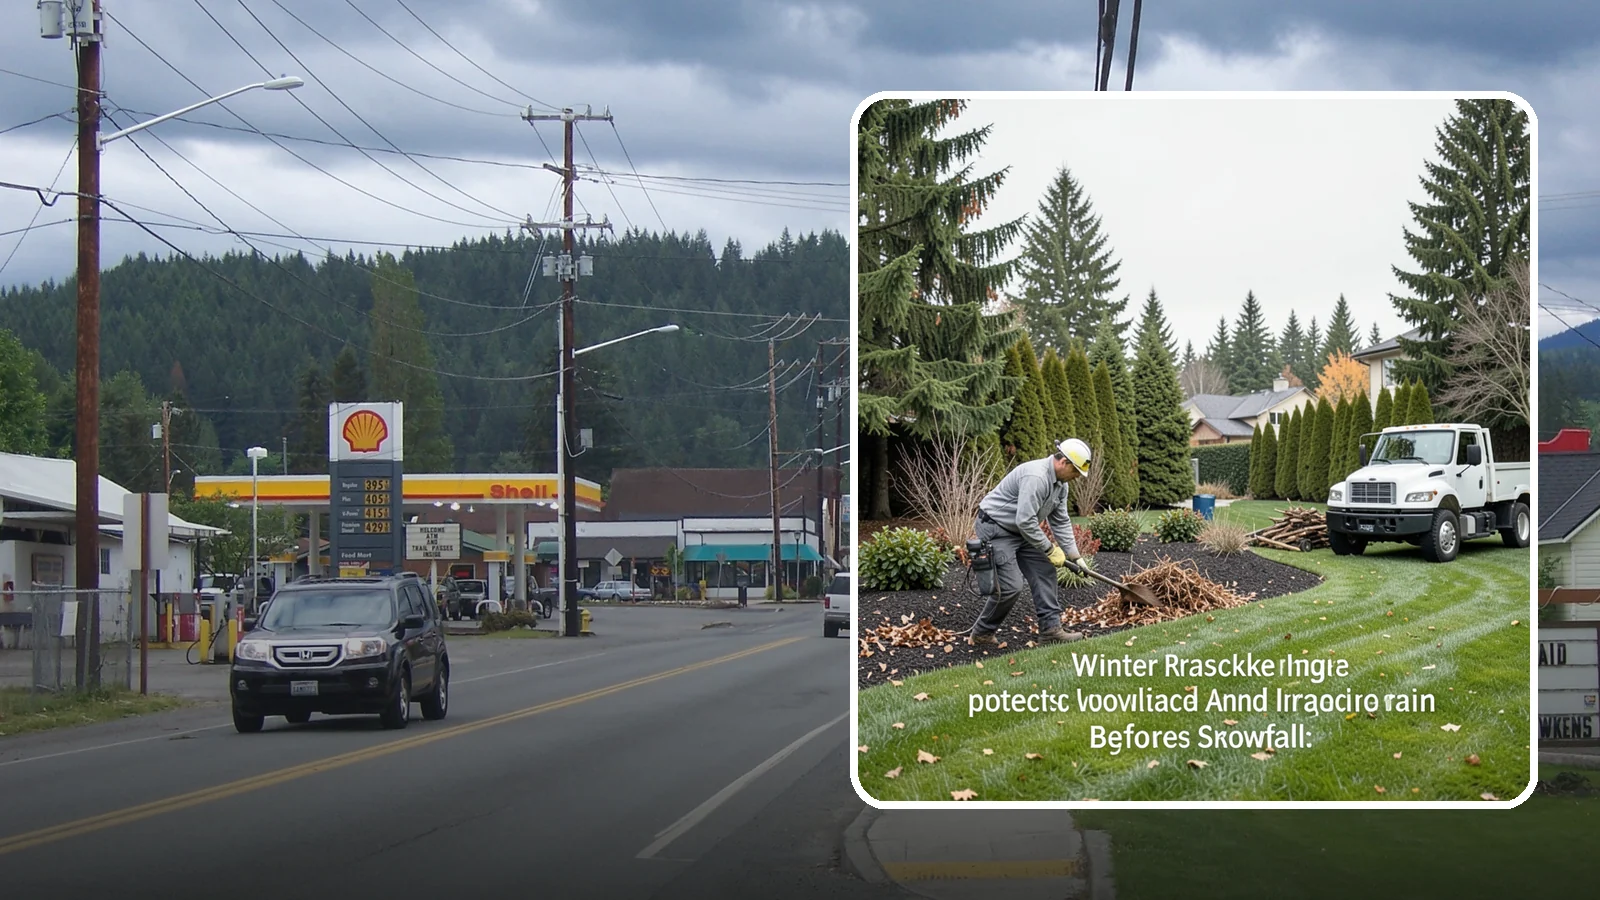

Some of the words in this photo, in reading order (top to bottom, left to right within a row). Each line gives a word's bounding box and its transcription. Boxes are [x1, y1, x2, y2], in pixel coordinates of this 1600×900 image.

[366, 480, 383, 490] 395
[490, 484, 547, 499] Shell
[365, 494, 383, 504] 405
[365, 508, 383, 518] 415
[365, 522, 383, 532] 429
